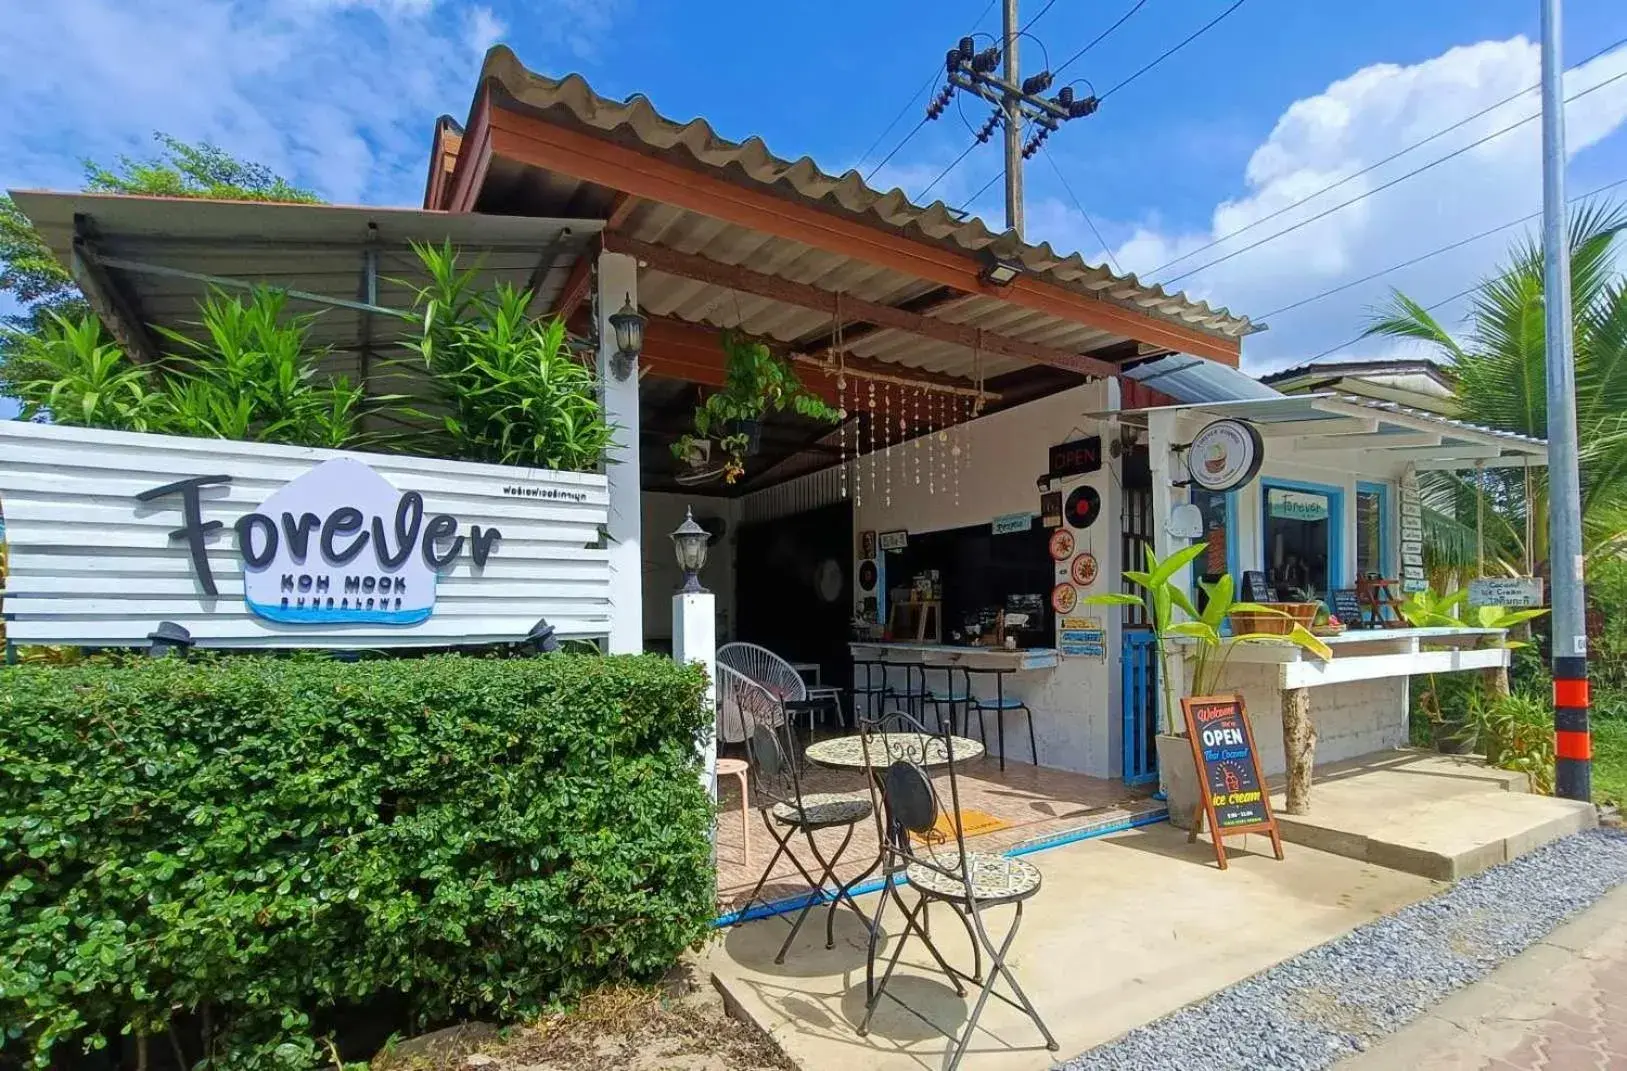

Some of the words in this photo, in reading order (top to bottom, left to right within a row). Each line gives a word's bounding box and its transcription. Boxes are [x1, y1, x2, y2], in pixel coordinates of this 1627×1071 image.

[1055, 448, 1095, 470] OPEN
[135, 474, 502, 595] Forever
[280, 573, 330, 593] KOH
[344, 575, 407, 594] MOOK
[280, 597, 402, 610] BUNGALOWS
[1203, 728, 1243, 747] OPEN
